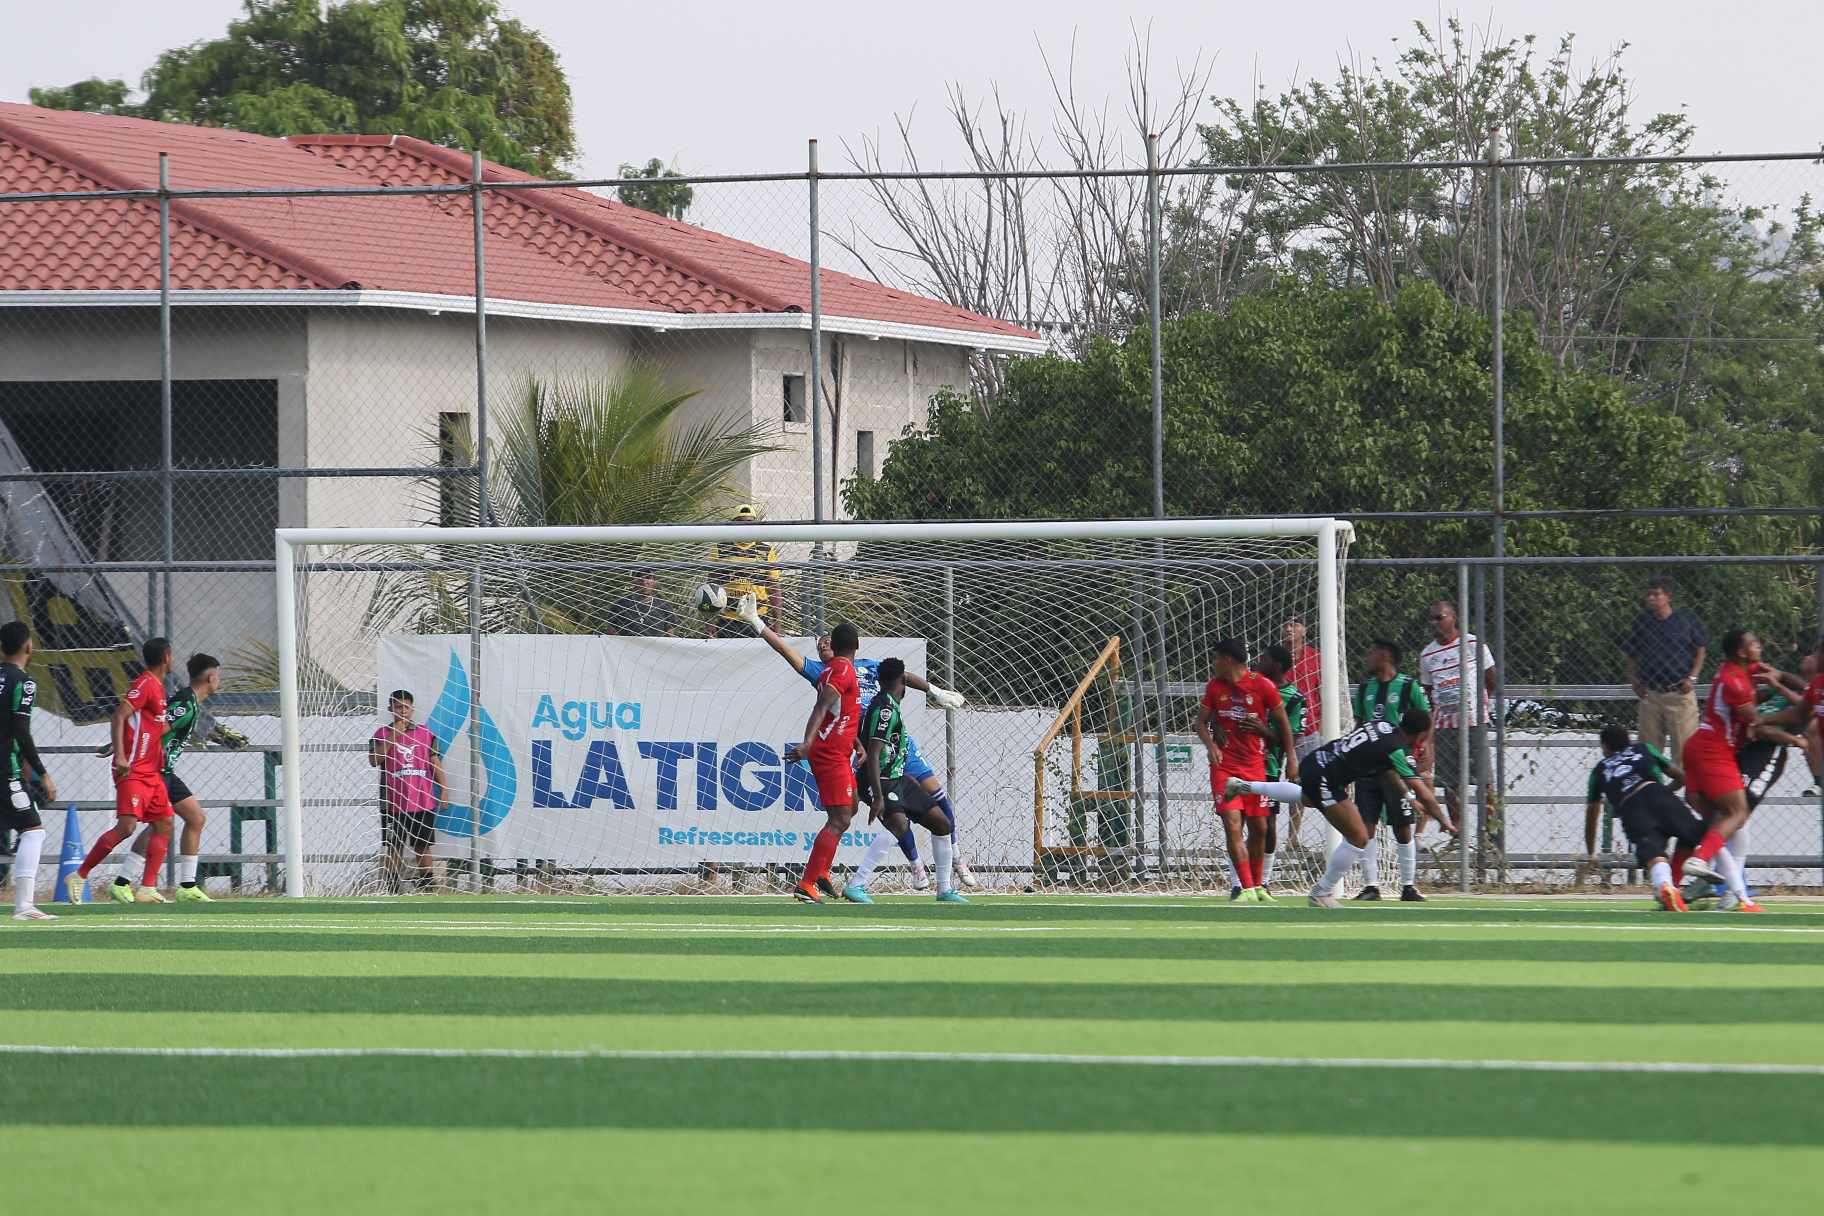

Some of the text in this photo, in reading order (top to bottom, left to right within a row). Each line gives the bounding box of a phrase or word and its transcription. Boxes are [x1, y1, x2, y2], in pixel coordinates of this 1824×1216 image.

[531, 694, 641, 741] Agua
[531, 740, 827, 812] LA TIG
[658, 826, 798, 847] Refrescante
[802, 832, 817, 852] y
